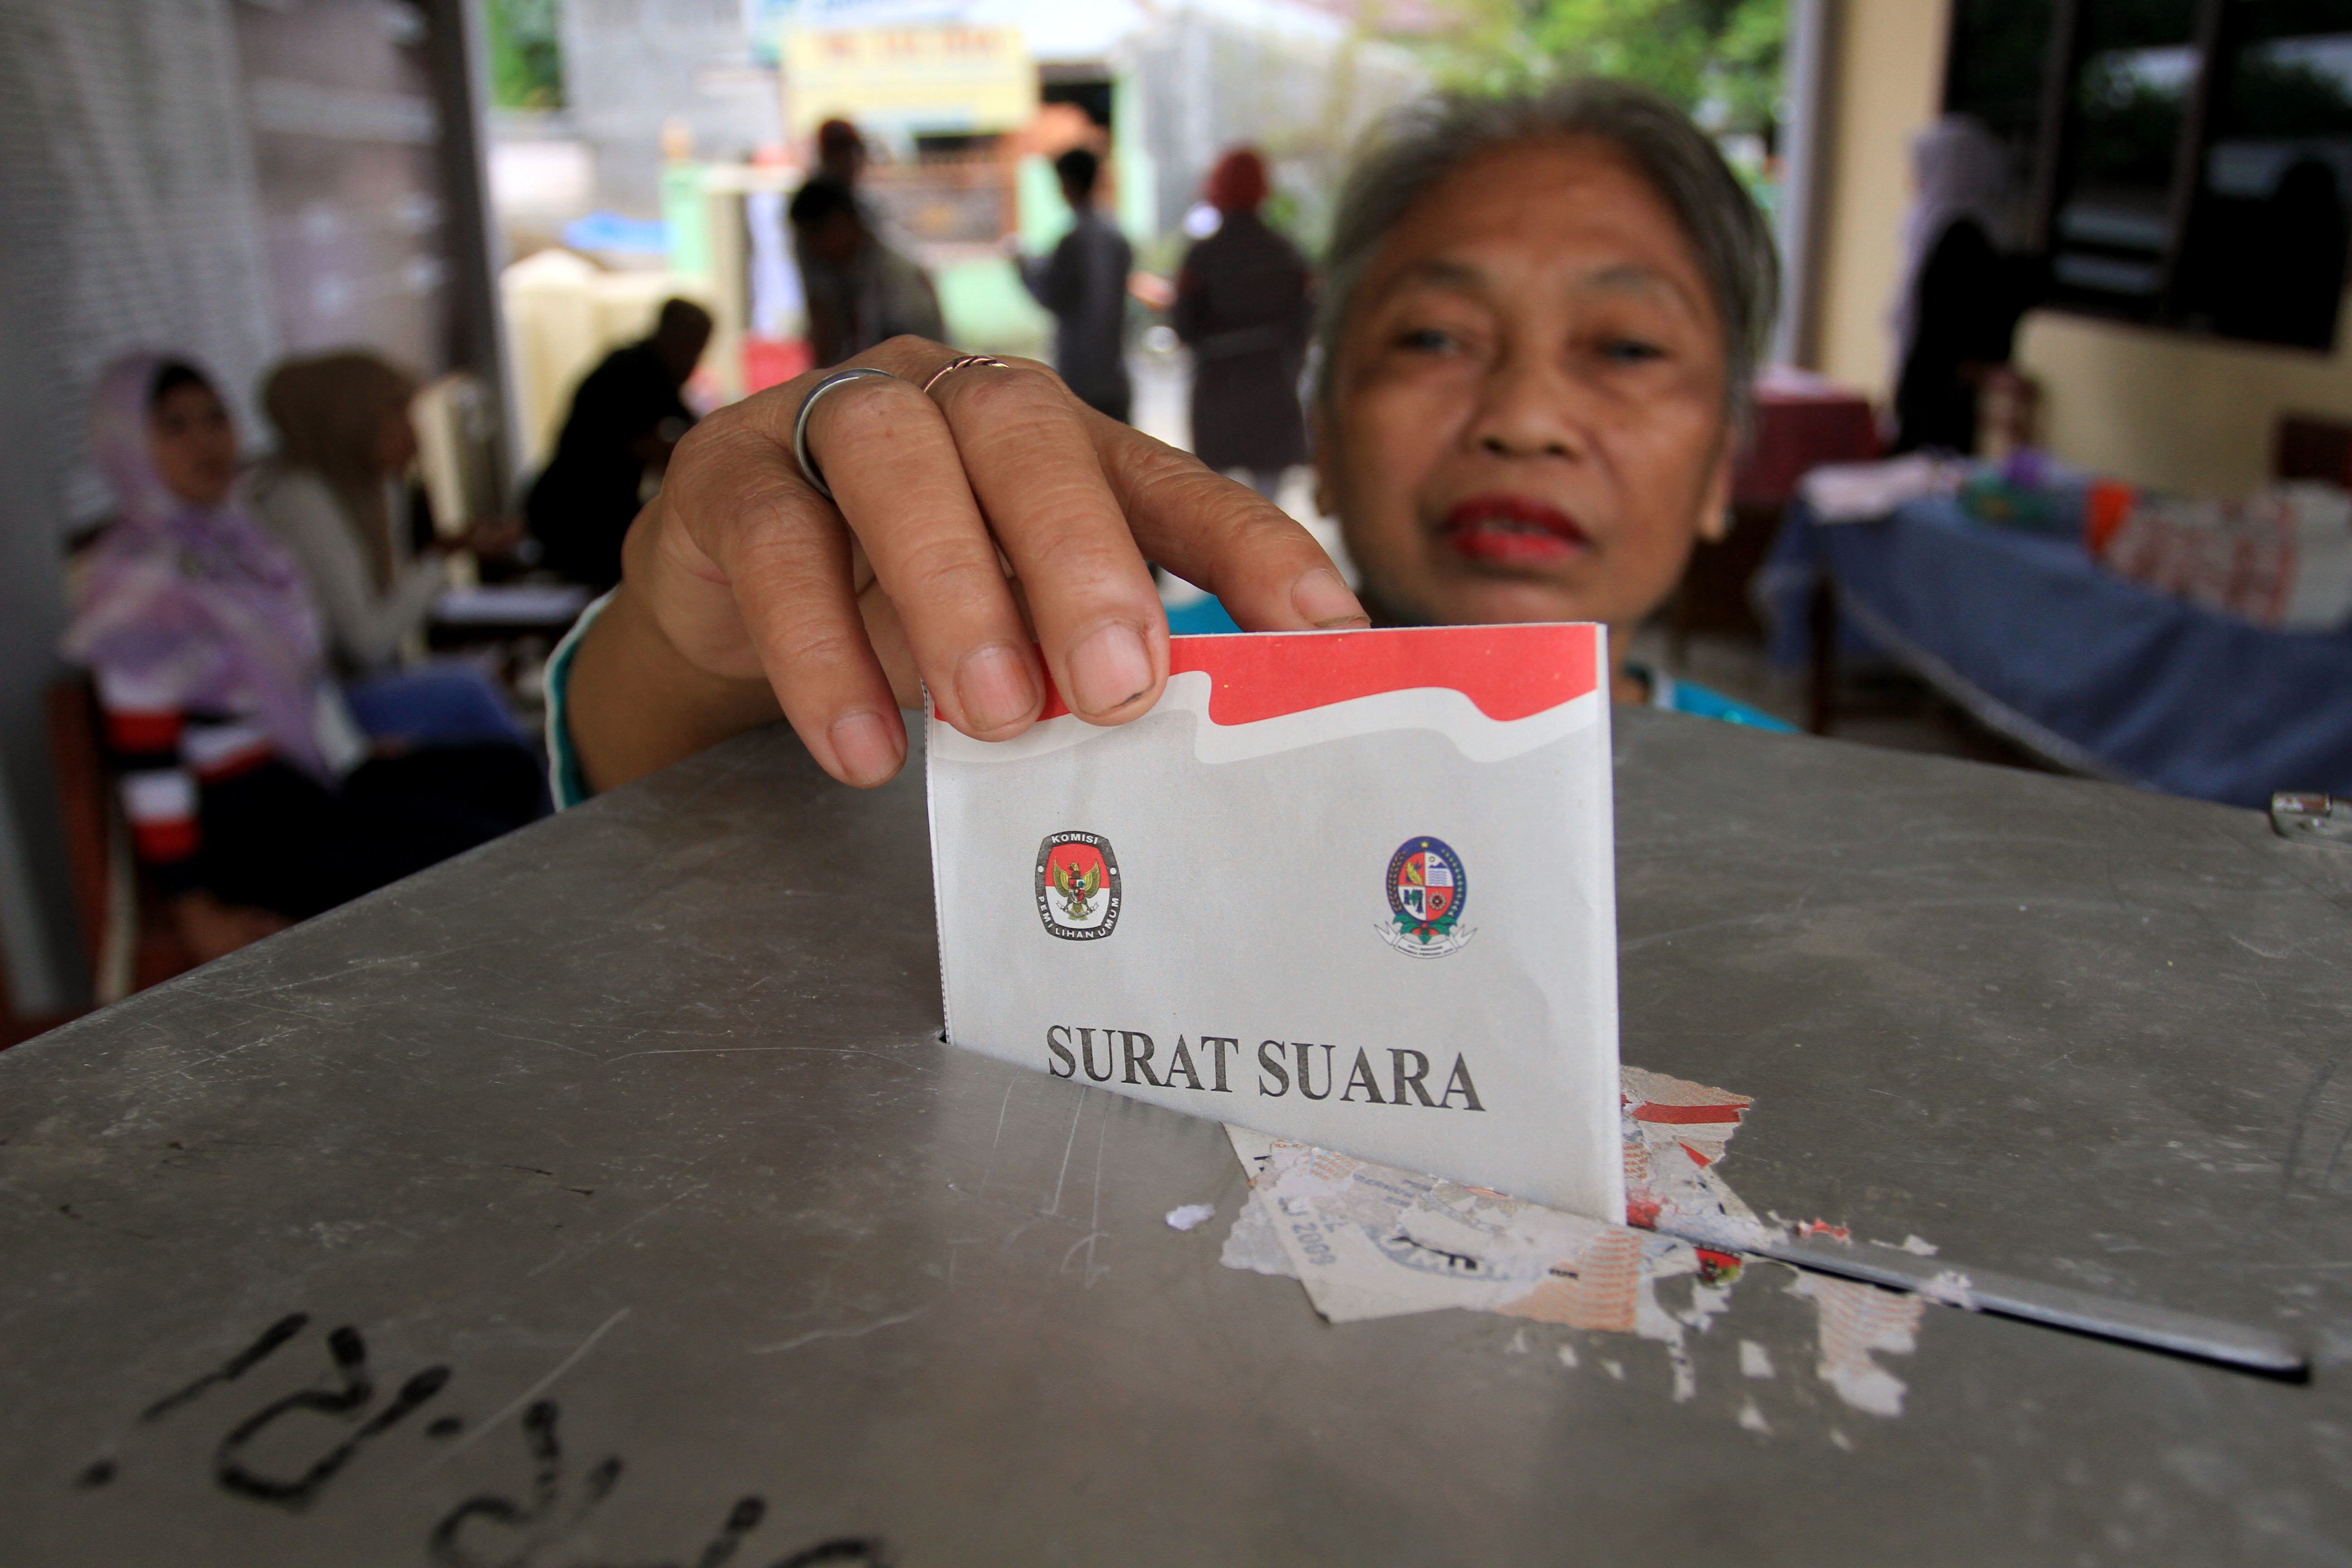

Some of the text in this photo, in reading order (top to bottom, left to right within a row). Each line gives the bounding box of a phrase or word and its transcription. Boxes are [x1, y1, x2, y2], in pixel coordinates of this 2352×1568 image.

[1051, 833, 1098, 845] KOMISI
[1038, 896, 1120, 939] PEMILIHAN UMUM
[1046, 1024, 1486, 1112] SURAT SUARA
